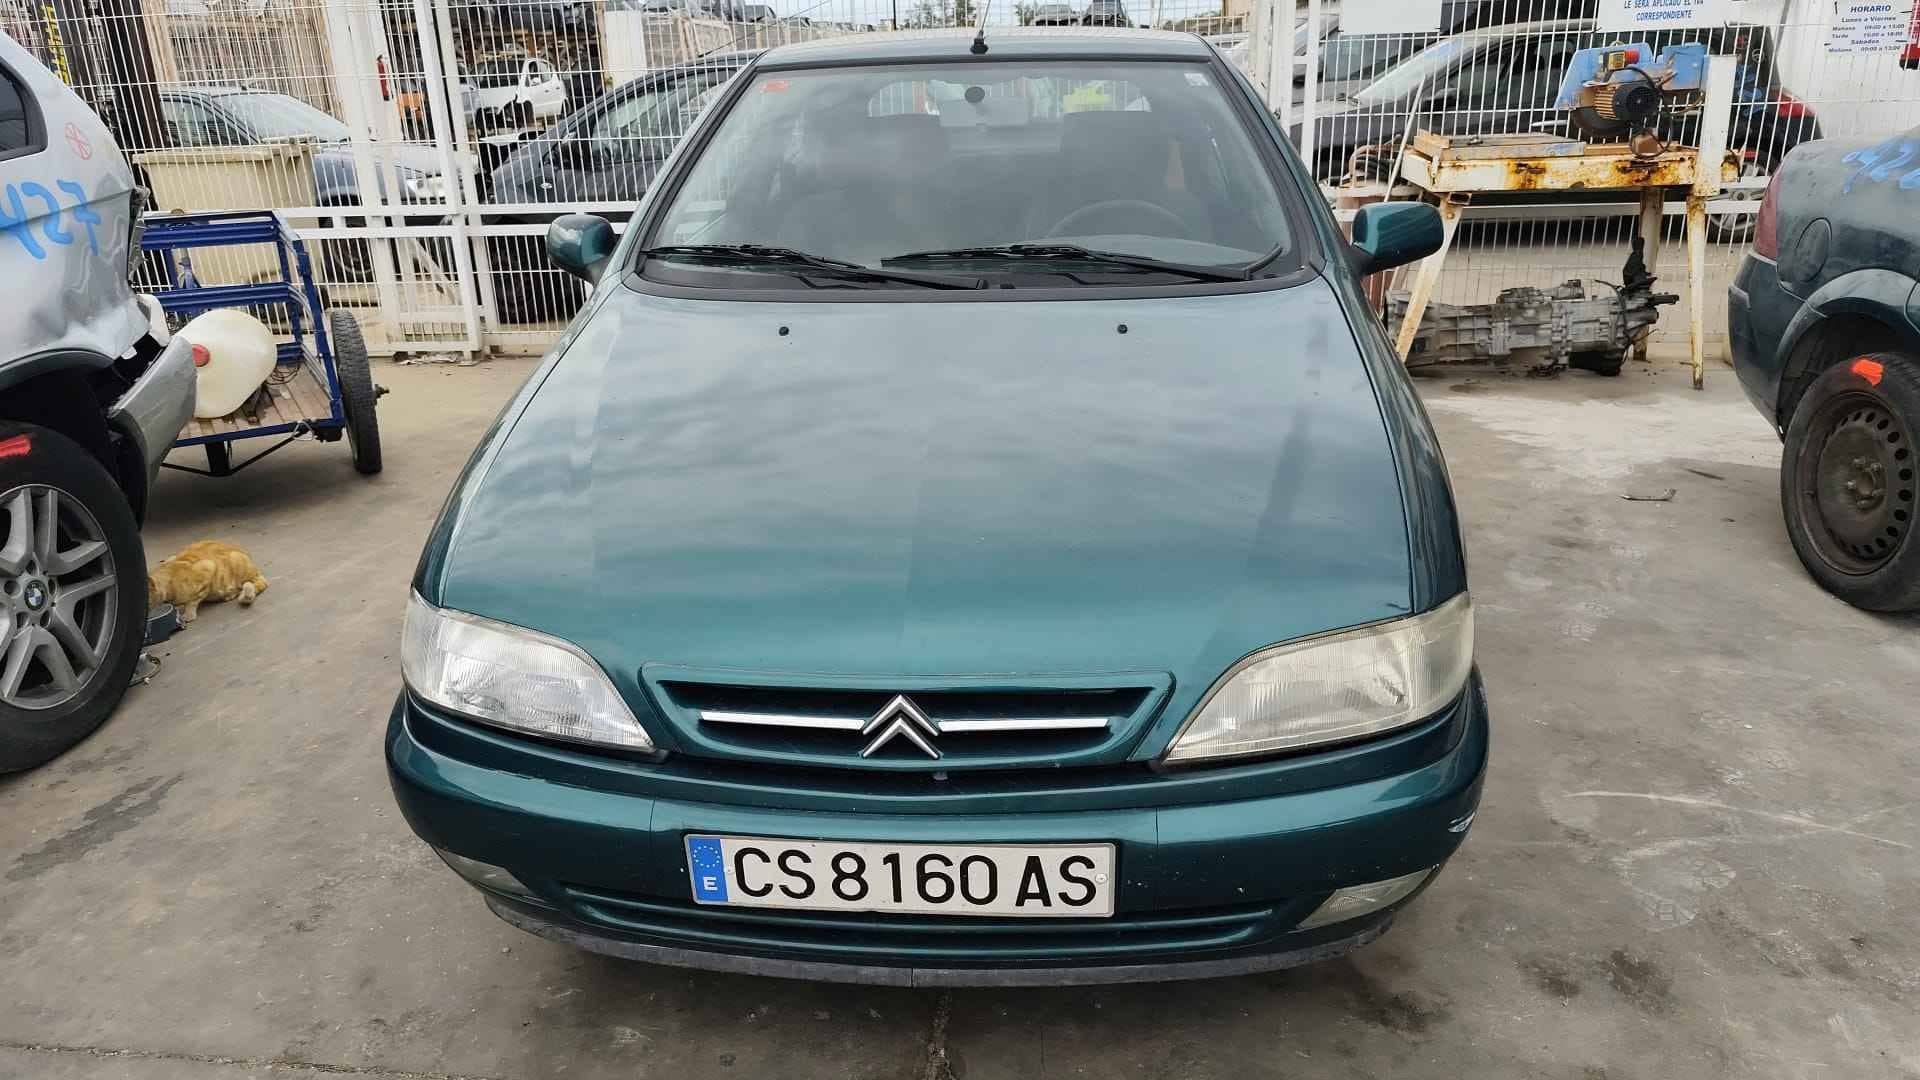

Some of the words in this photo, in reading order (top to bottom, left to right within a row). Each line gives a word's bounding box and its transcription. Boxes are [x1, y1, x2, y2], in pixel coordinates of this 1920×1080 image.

[1624, 0, 1632, 9] LE
[1850, 5, 1891, 13] HORARIO
[1636, 10, 1692, 21] CORRESPONDIENTE
[733, 846, 816, 900] CS
[831, 851, 998, 907] 8160
[1015, 855, 1098, 908] AS
[703, 876, 718, 891] E
